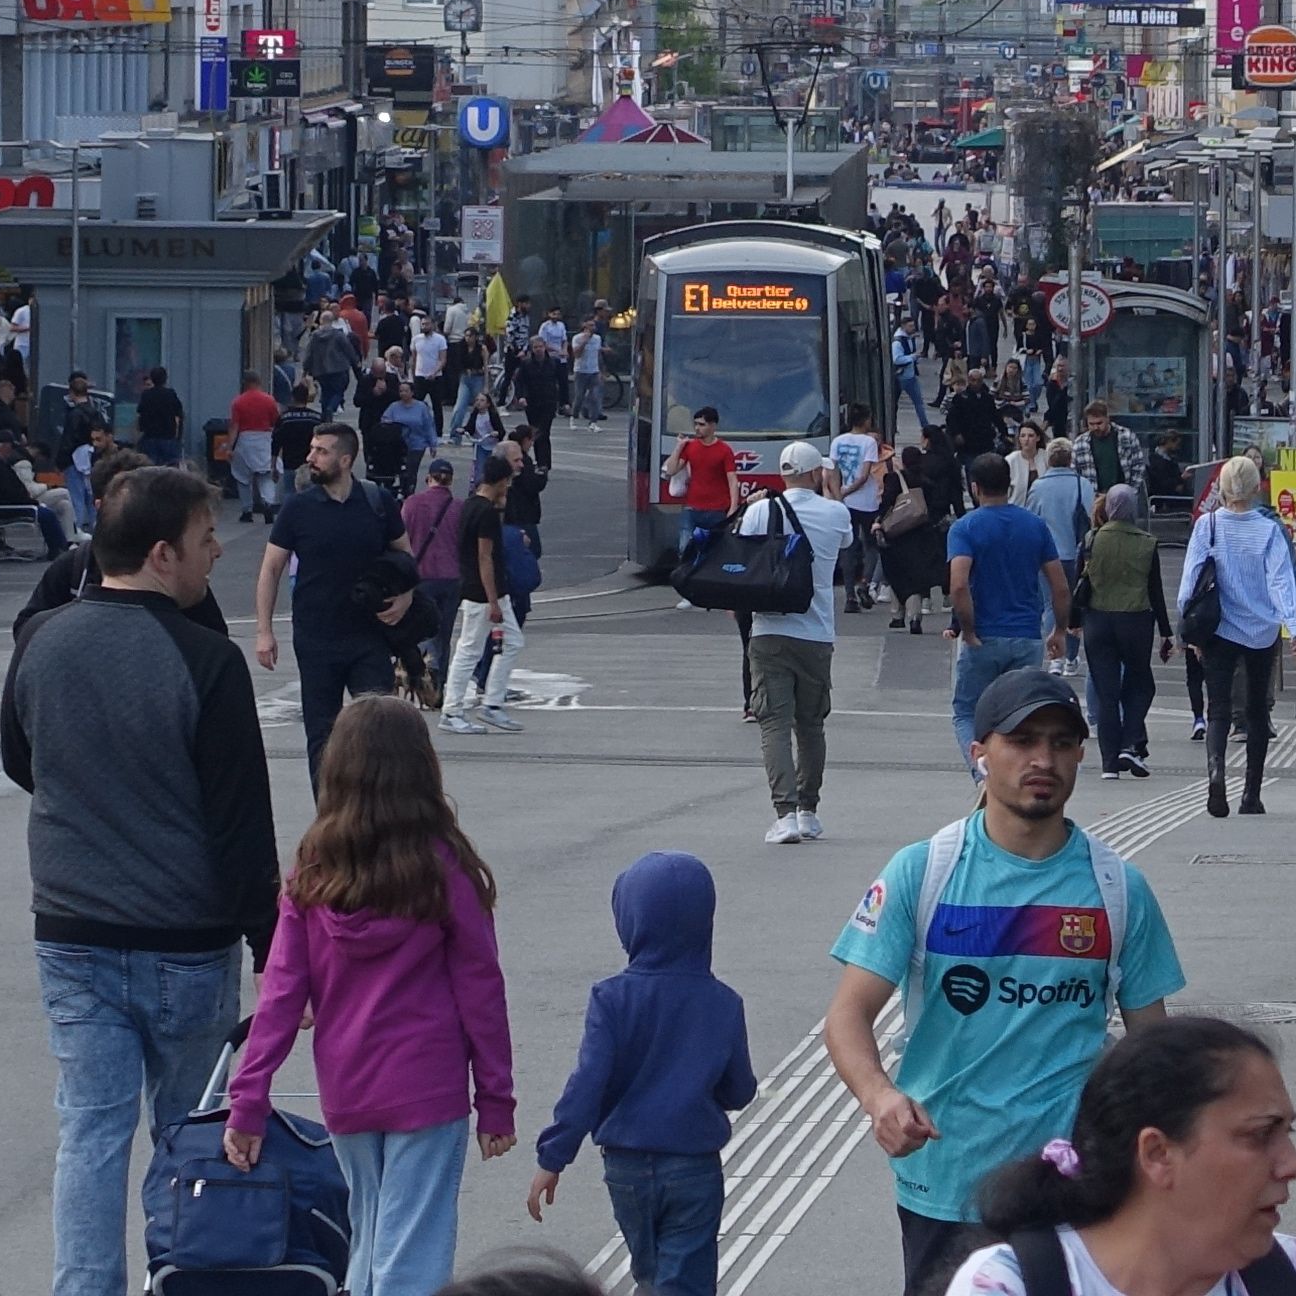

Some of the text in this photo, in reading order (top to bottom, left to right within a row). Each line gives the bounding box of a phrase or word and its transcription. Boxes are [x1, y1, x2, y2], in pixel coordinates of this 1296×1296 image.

[467, 106, 500, 142] U
[57, 237, 217, 258] BLUMEN
[684, 284, 794, 312] E1 Quartier
[712, 297, 794, 310] Belvedere
[997, 976, 1096, 1009] Spotify
